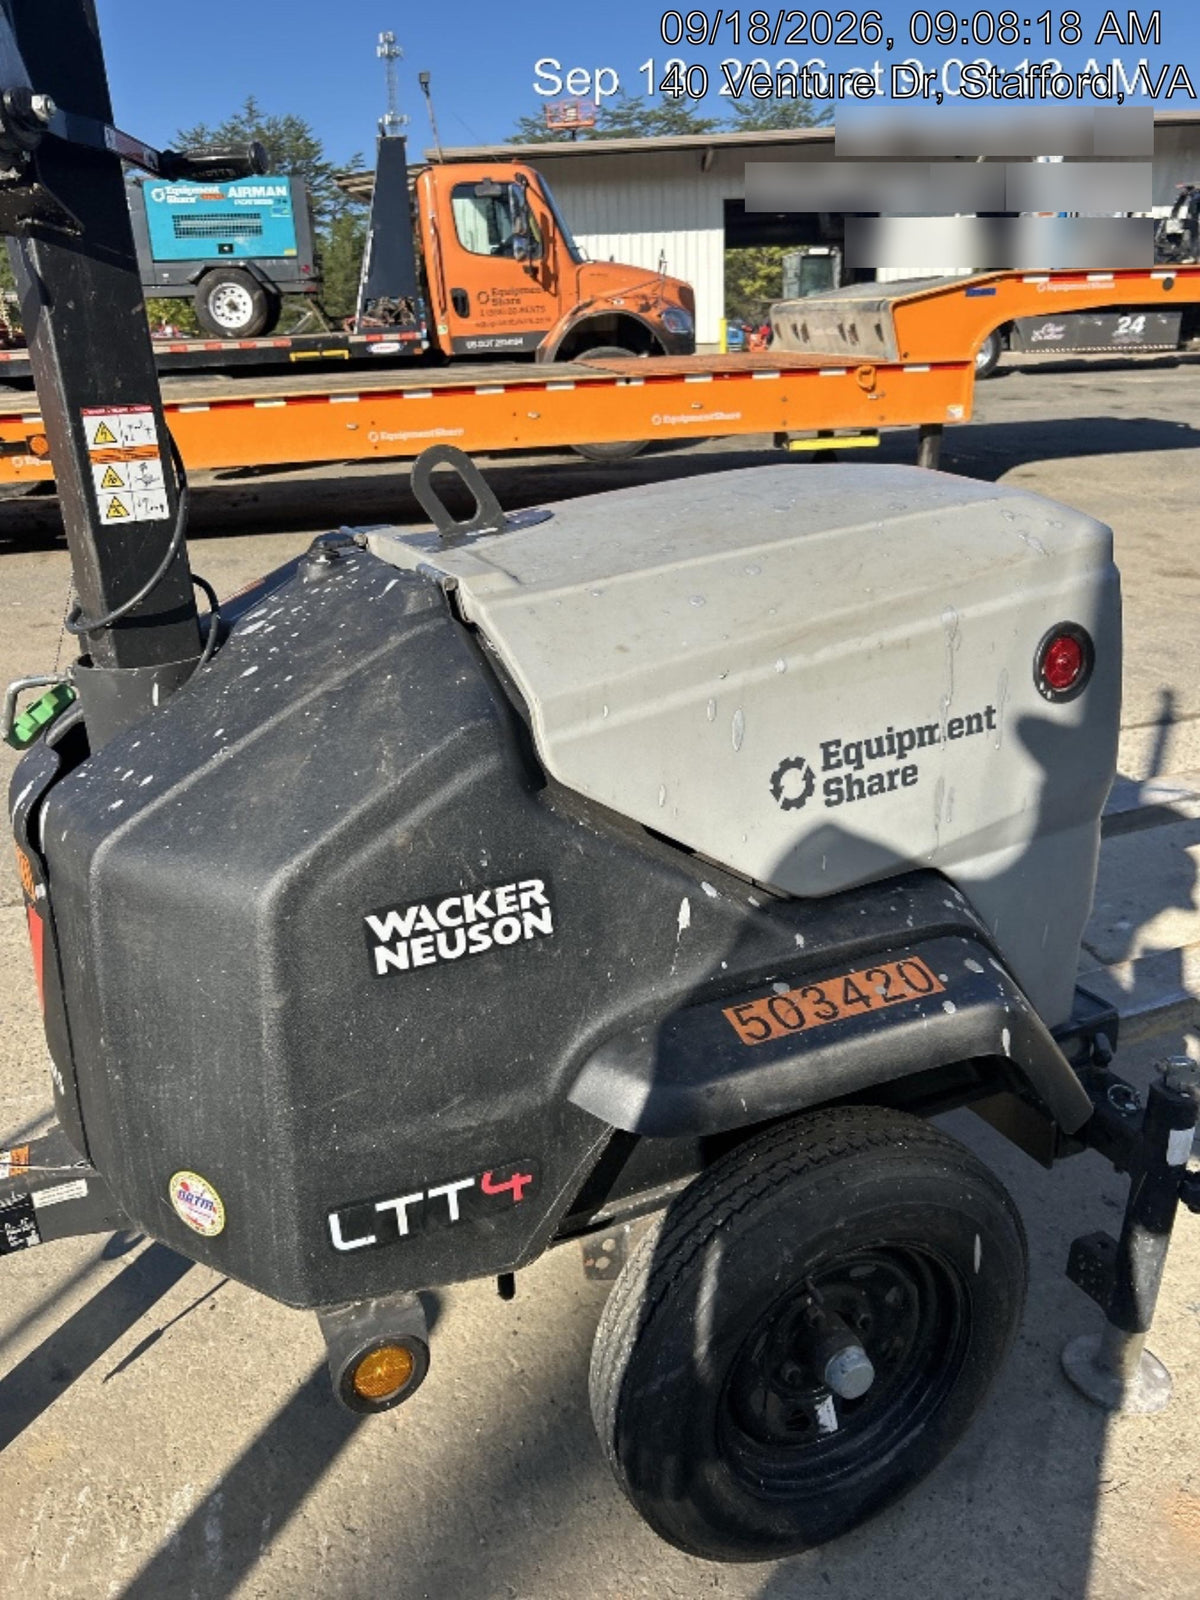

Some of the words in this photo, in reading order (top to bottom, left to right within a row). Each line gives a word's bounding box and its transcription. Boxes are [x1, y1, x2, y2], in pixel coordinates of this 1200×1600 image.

[227, 186, 287, 198] AIRMAN
[819, 704, 997, 772] Equipment
[822, 764, 919, 808] Share
[364, 879, 551, 942] WACKER
[374, 906, 554, 975] NEUSON
[732, 960, 934, 1041] 503420
